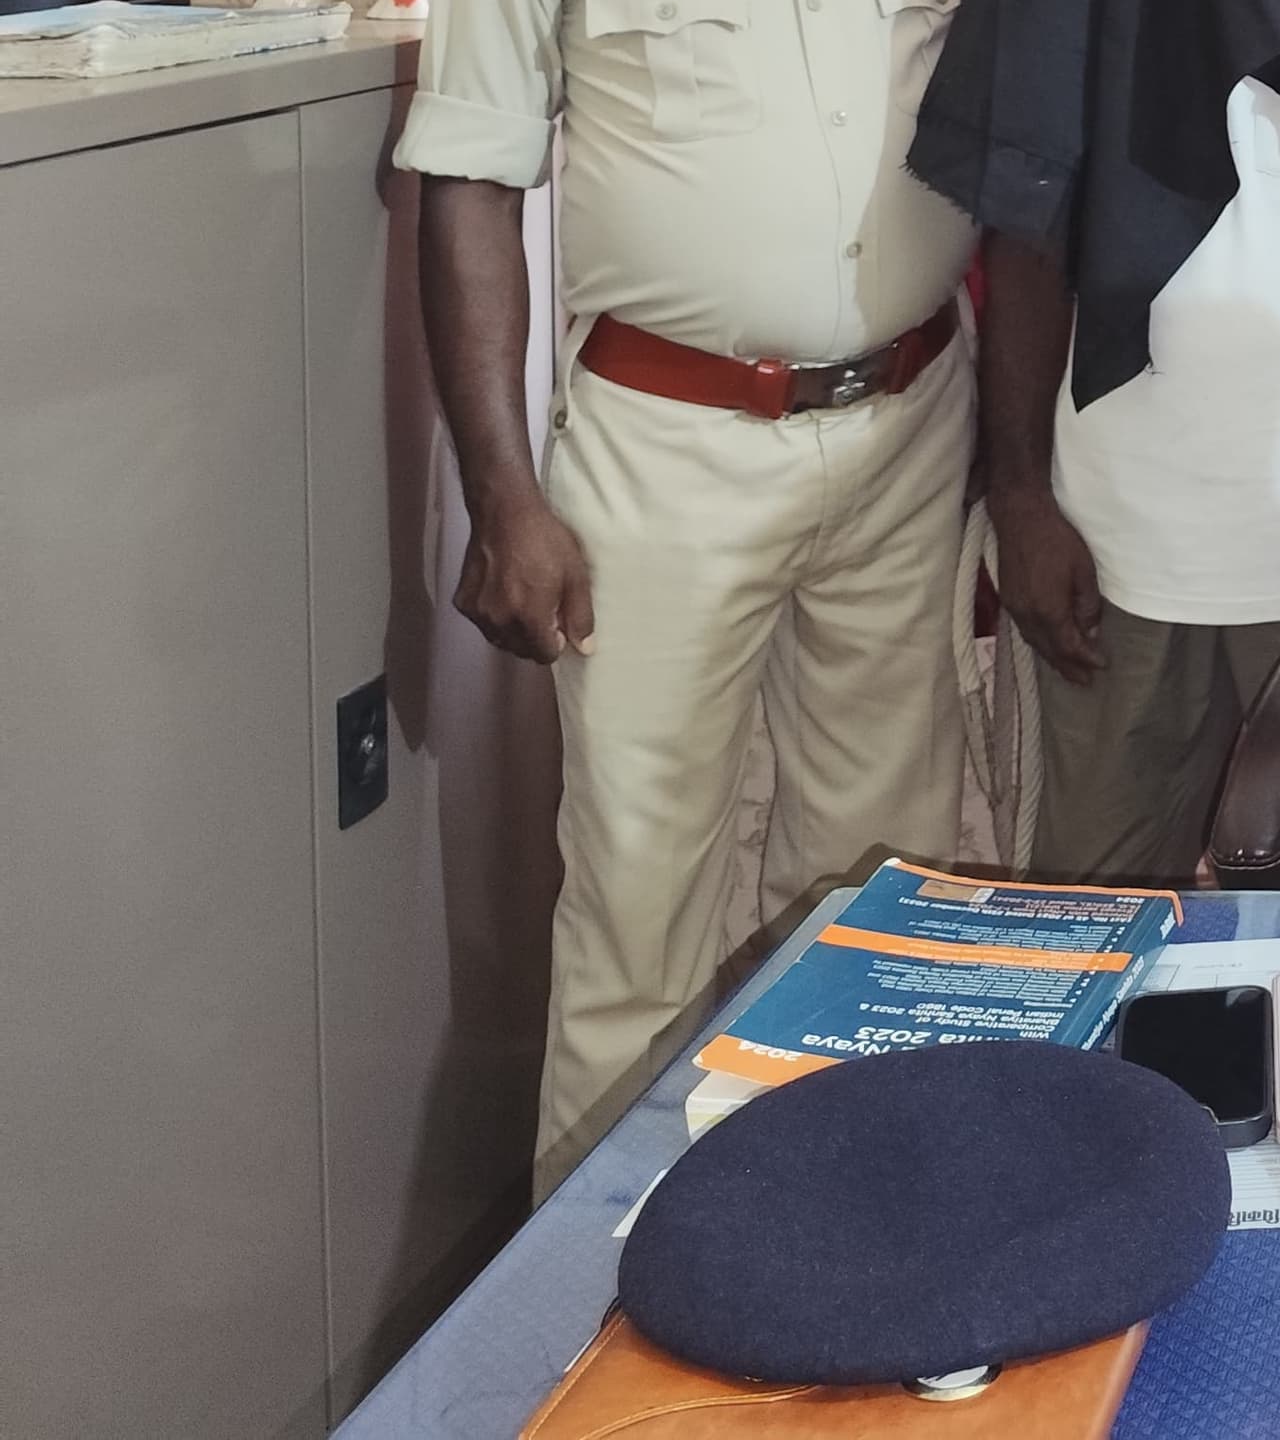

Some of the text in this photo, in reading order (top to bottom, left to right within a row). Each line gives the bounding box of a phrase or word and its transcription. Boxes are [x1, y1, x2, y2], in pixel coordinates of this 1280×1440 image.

[872, 1005, 905, 1014] 2023
[908, 1008, 955, 1019] Sanhita
[916, 1003, 1065, 1018] Indian Penal Code 1860
[956, 1012, 997, 1021] Nyaya
[1001, 1015, 1060, 1025] Bharatiya
[934, 1017, 971, 1027] Study
[974, 1020, 1056, 1032] Comparative
[853, 1026, 931, 1044] 2023
[1019, 1031, 1050, 1039] With
[801, 1034, 891, 1056] Nyaya
